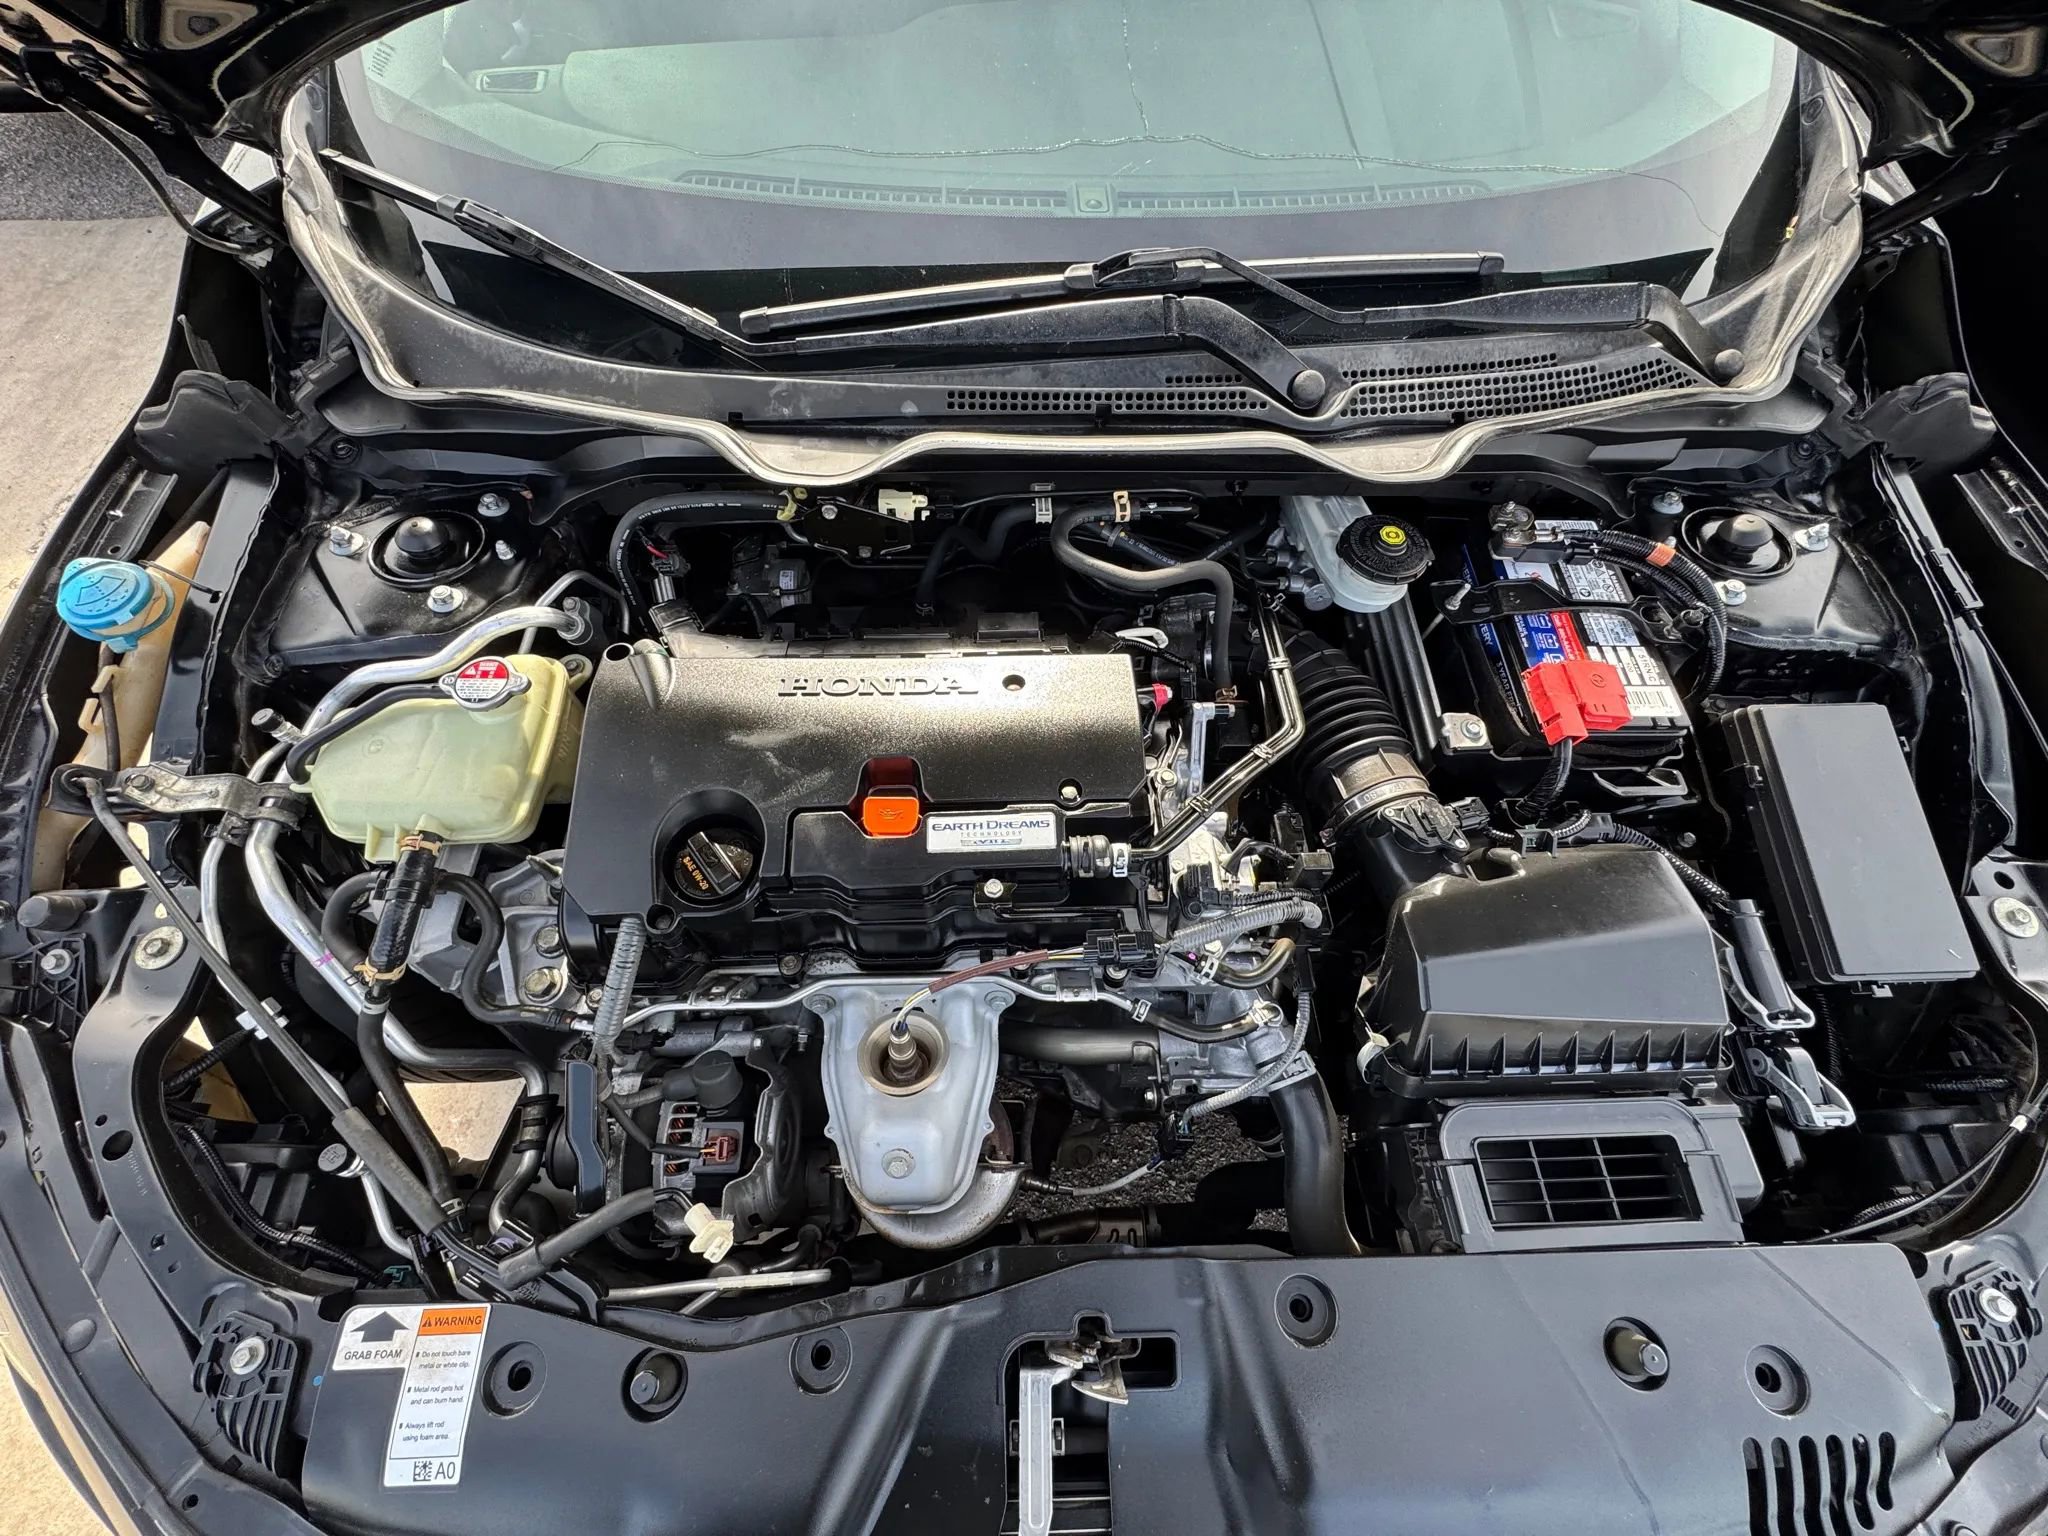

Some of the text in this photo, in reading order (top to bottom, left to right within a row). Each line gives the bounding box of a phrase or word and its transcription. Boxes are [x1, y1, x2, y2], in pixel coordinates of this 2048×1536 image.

[1498, 667, 1511, 692] YEAR
[778, 675, 979, 697] HONDA
[932, 822, 983, 832] EARTH
[960, 830, 1022, 838] TECHNOLOGY
[682, 856, 709, 891] SAE 0W-20
[434, 1315, 482, 1327] WARNING
[344, 1349, 403, 1360] GRAB FOAM
[441, 1385, 453, 1393] gets
[405, 1422, 425, 1430] Always
[402, 1434, 418, 1442] using
